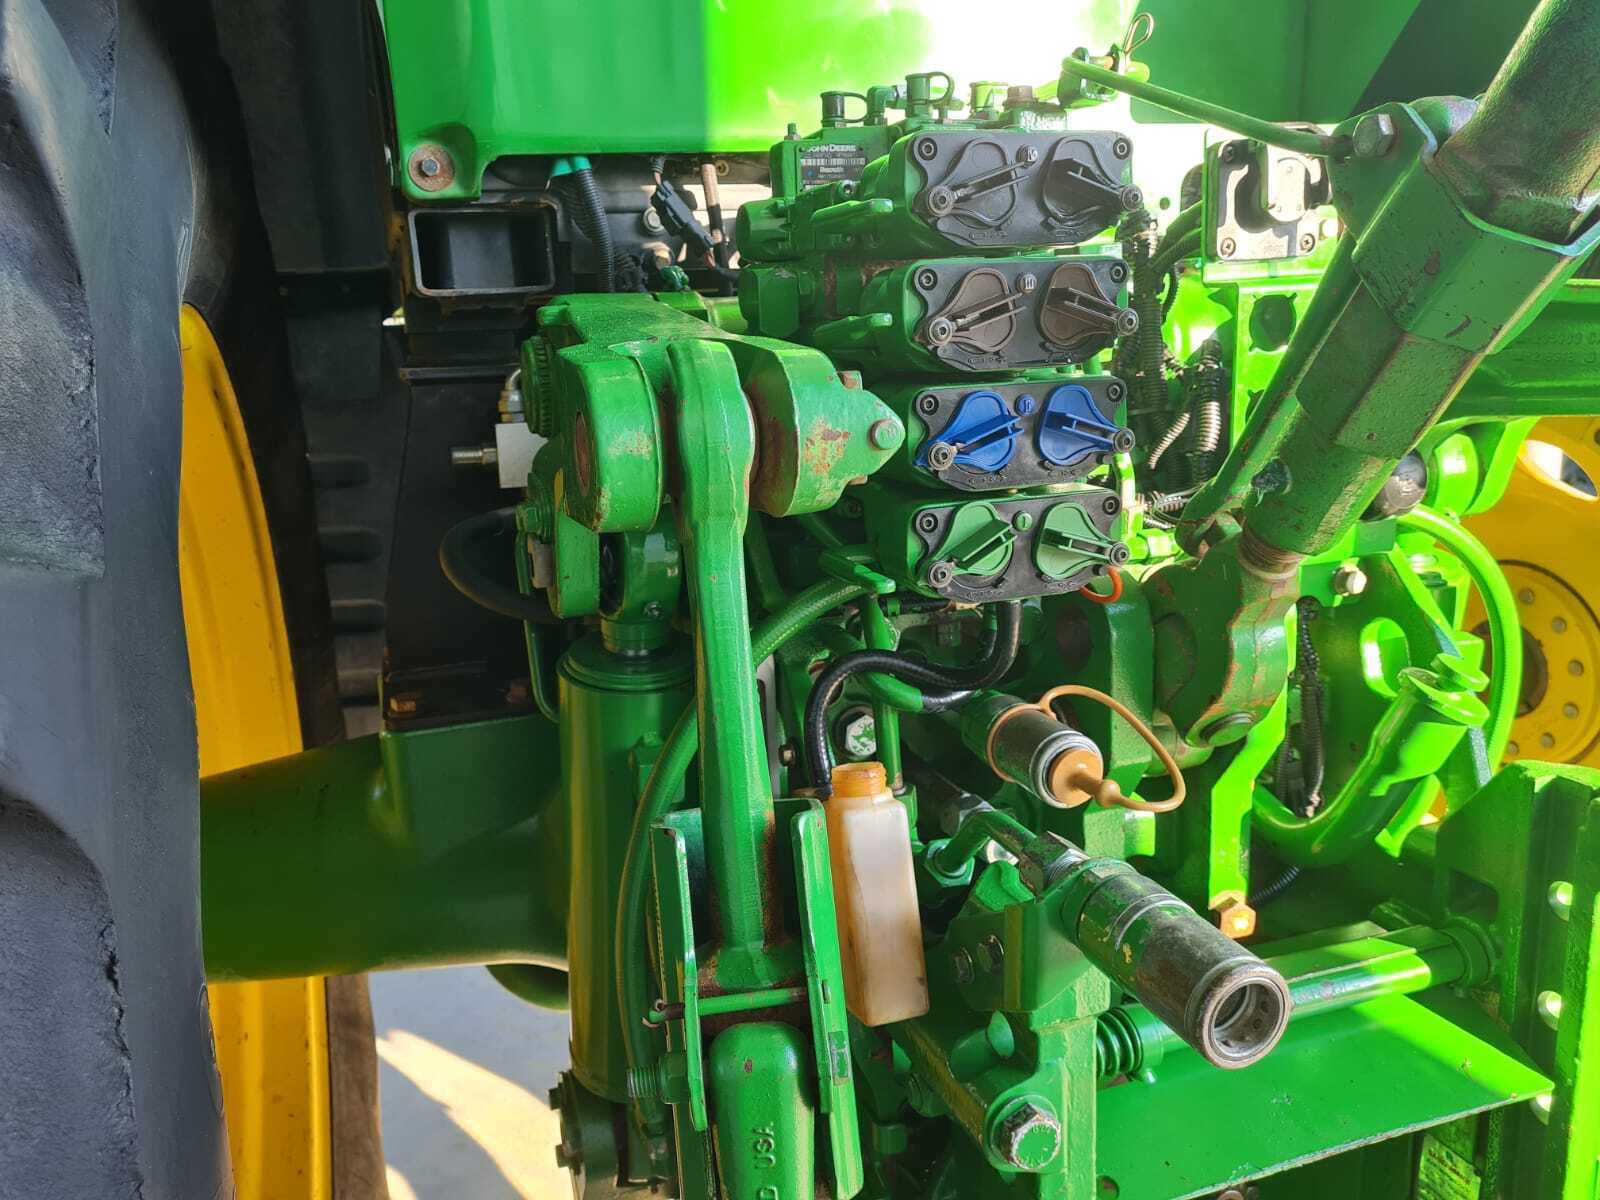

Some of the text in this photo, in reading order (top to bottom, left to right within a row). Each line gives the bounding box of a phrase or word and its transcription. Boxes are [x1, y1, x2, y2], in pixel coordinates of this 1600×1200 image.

[807, 144, 857, 153] JOHN DEERE
[752, 1121, 776, 1169] USA
